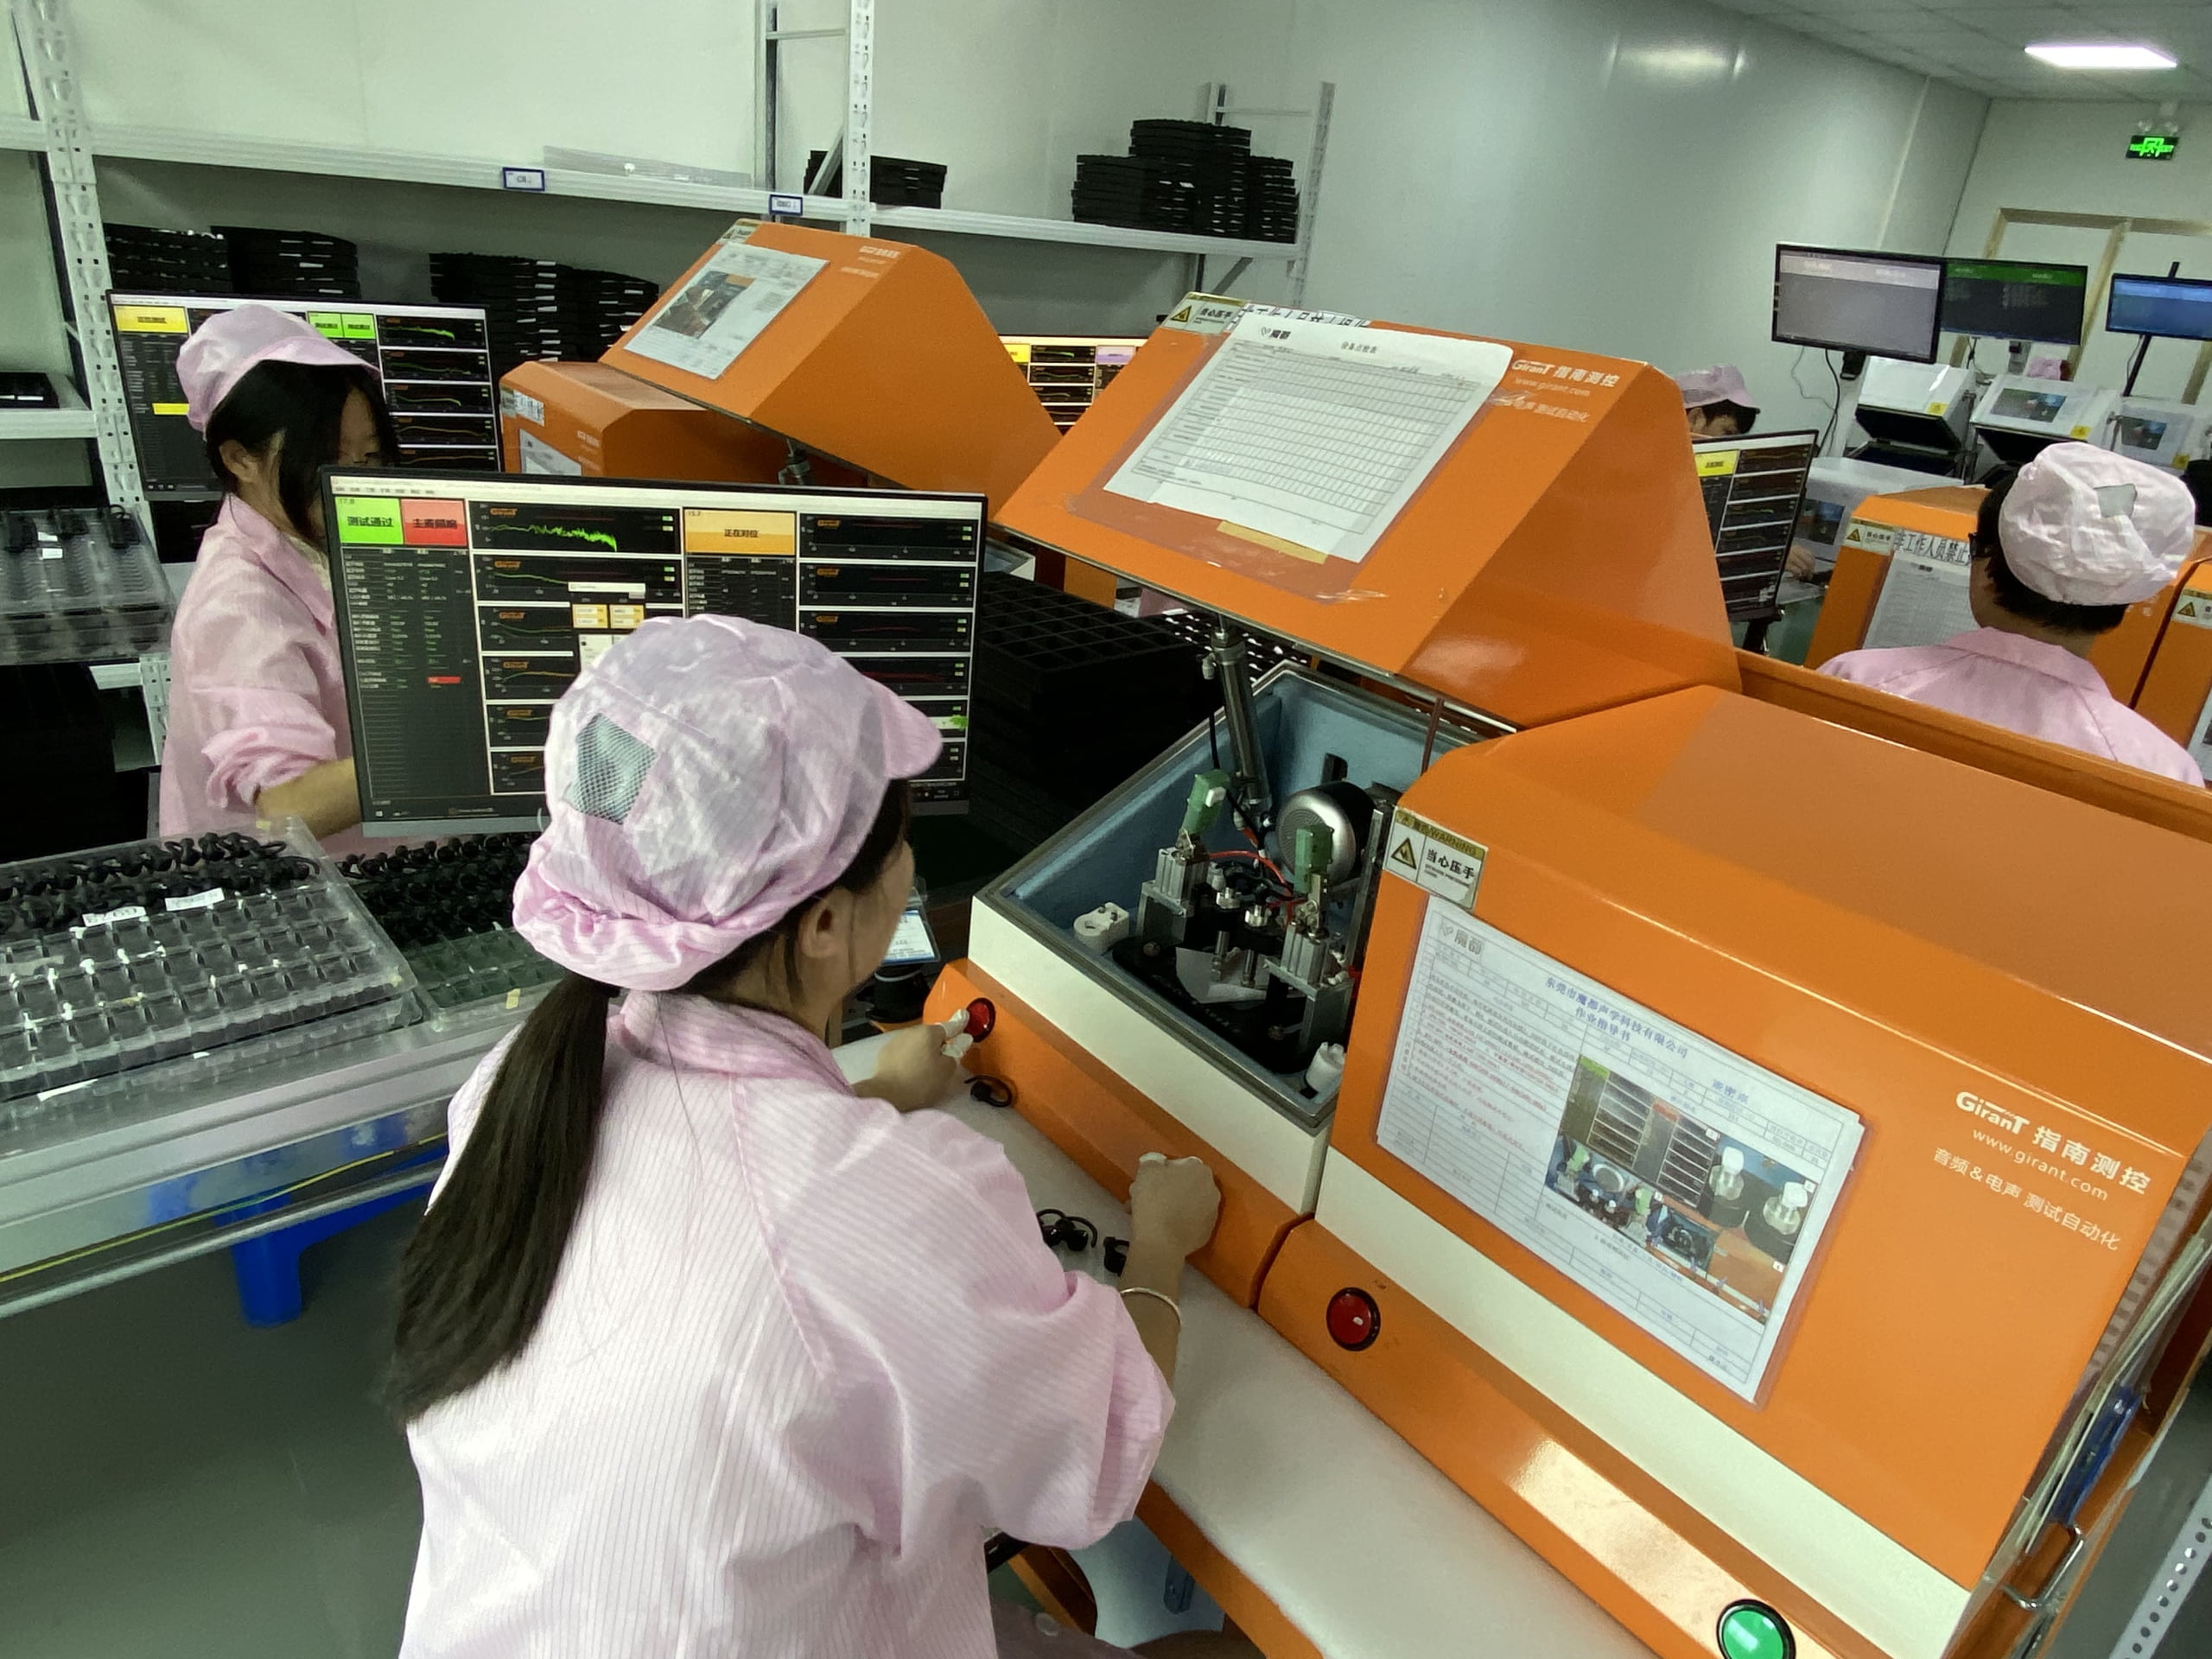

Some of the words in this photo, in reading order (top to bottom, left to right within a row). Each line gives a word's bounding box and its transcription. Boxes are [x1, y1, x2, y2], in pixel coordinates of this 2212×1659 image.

[1515, 377, 1591, 397] www.girant.com
[347, 516, 394, 528] 测试通过
[724, 528, 759, 538] 正在对位
[1427, 849, 1474, 879] 当心压手
[1575, 1007, 1630, 1042] 作业指导书
[1973, 1128, 2108, 1201] www.girant.com
[2032, 1126, 2152, 1195] 指南测控
[1933, 1147, 2024, 1198] 音频&电声
[2023, 1192, 2121, 1251] 测试自动化
